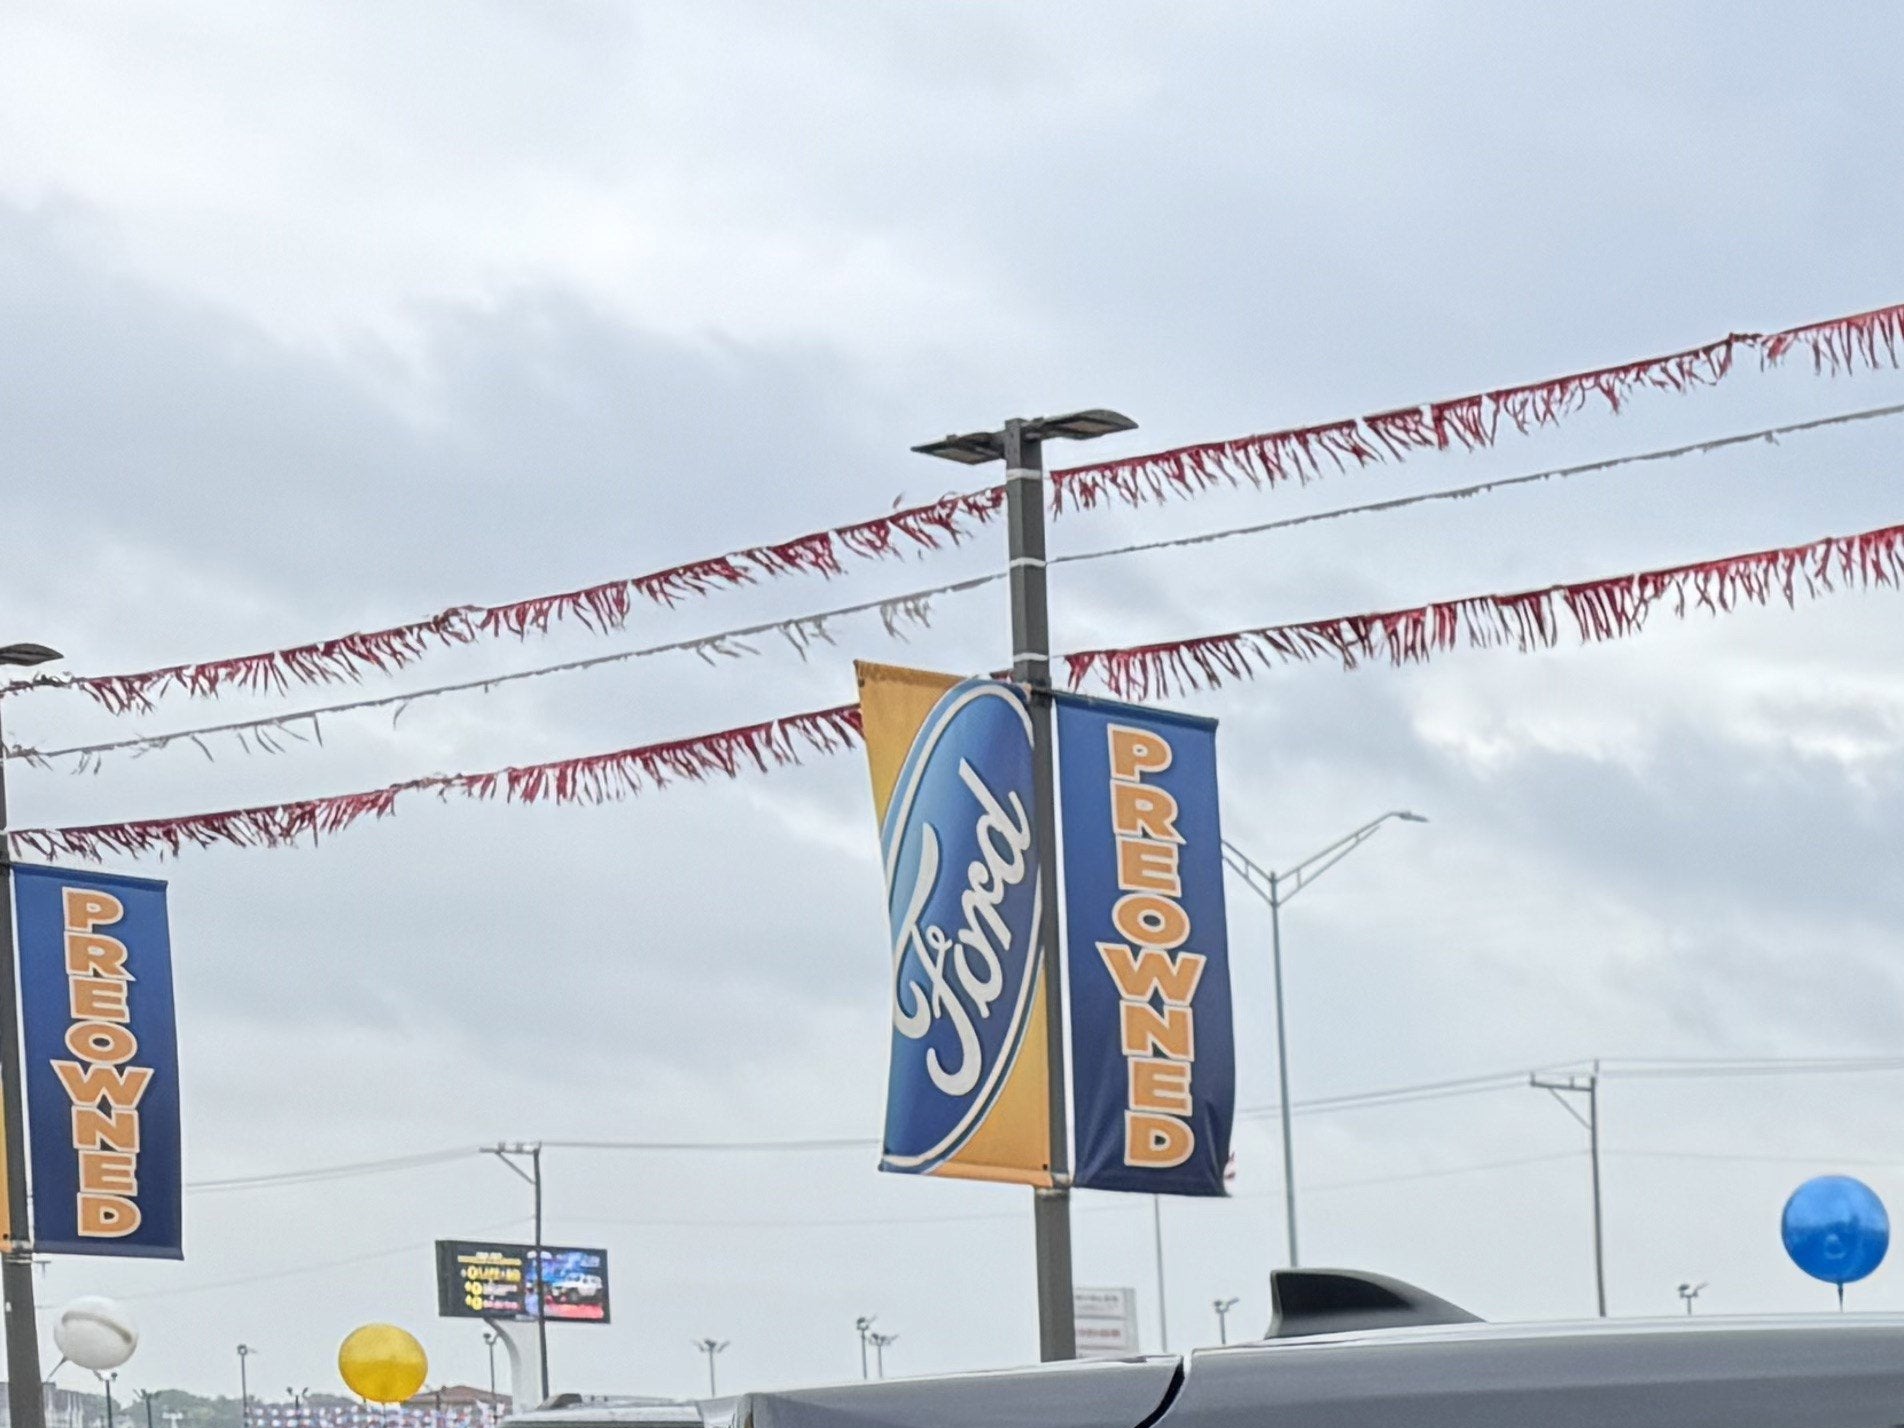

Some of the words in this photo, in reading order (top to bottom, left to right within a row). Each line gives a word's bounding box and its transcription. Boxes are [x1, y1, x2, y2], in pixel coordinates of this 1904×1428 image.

[50, 886, 154, 1238] PREOWNED
[894, 758, 1031, 1096] Ford
[1096, 723, 1206, 1167] PREOWNED
